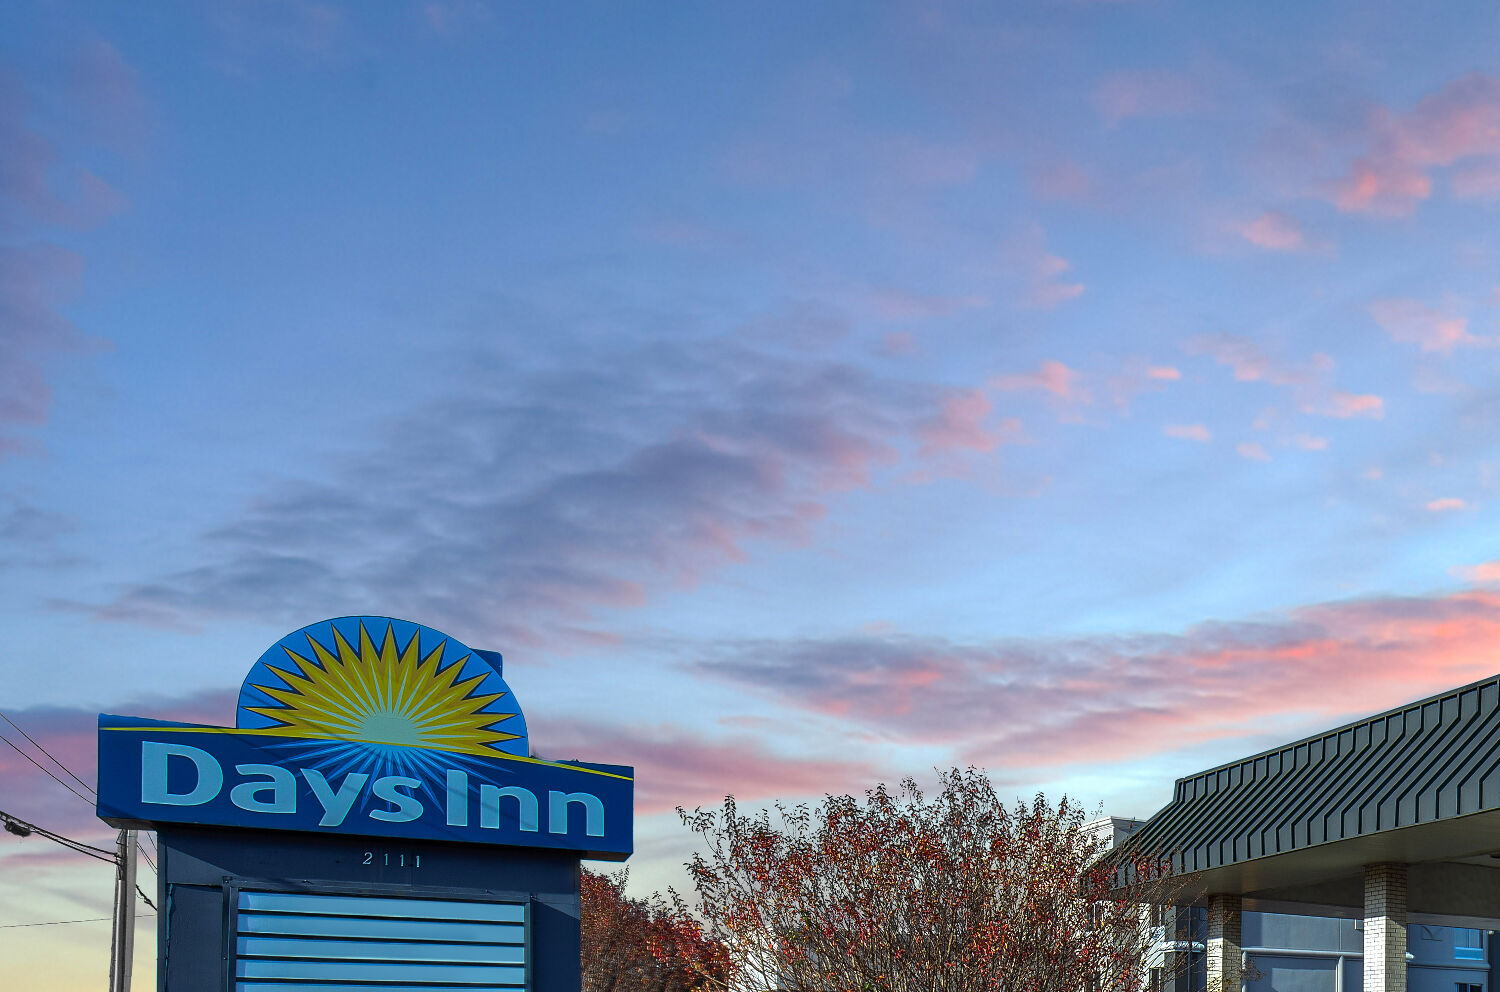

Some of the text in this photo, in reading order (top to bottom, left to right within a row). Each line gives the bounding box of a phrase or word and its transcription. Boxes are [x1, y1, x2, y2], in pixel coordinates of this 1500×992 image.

[141, 740, 605, 838] Days Inn
[362, 851, 420, 868] 2111
